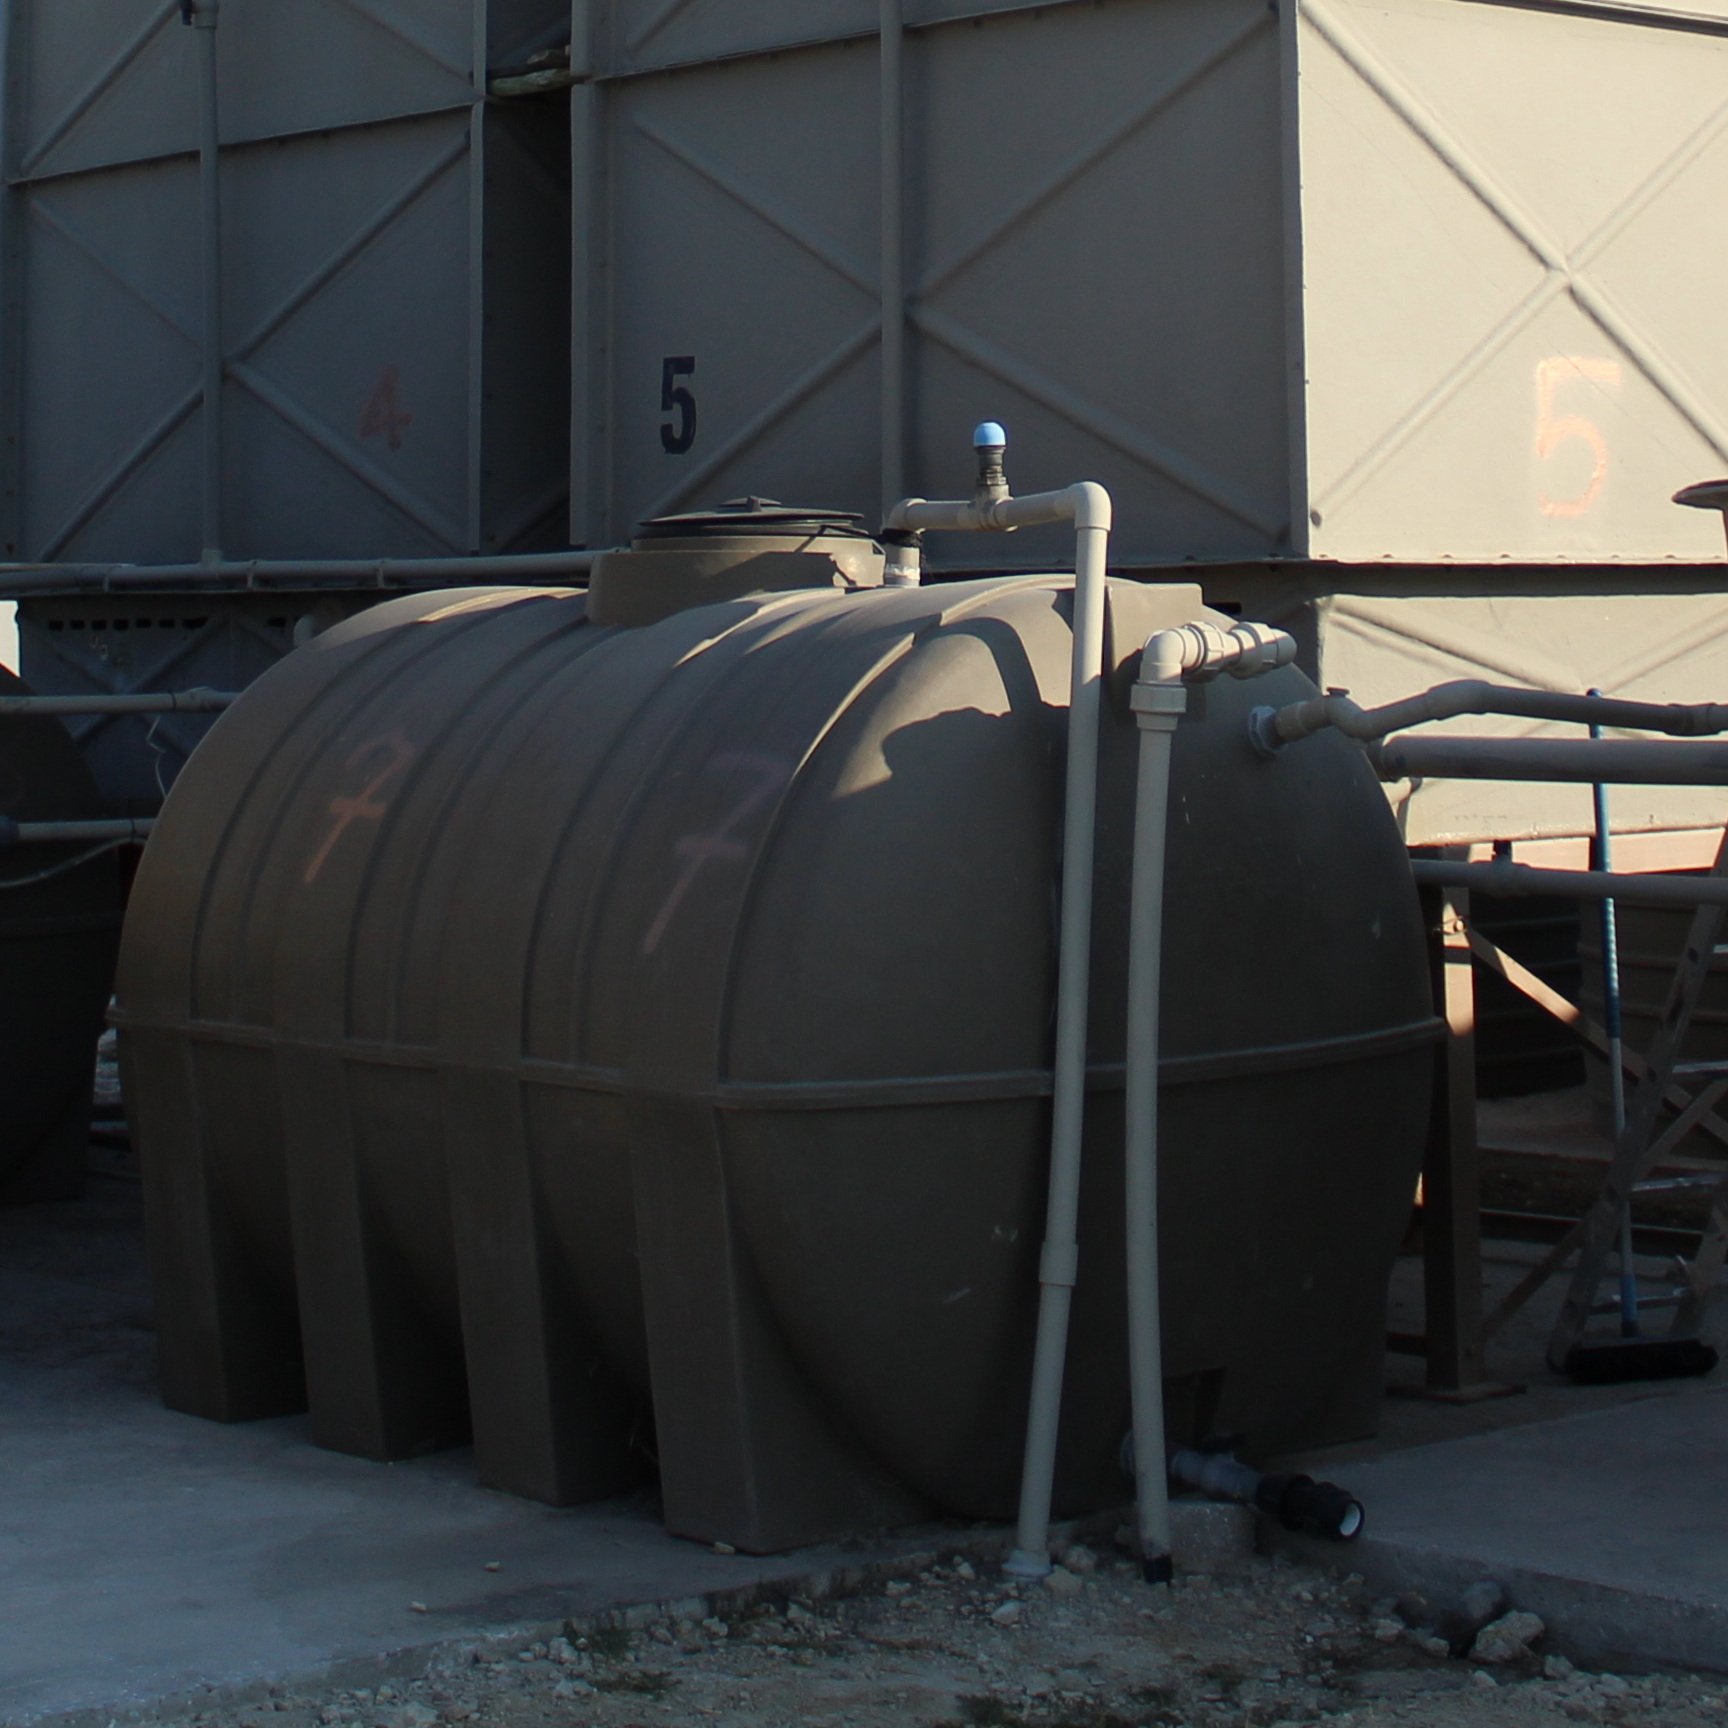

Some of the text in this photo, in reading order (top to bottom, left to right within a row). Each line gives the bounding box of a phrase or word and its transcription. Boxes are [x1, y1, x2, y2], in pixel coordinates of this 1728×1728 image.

[359, 365, 414, 450] 4
[660, 355, 697, 454] 5
[1536, 356, 1622, 516] 5
[304, 728, 416, 883] 7
[639, 749, 792, 956] 7
